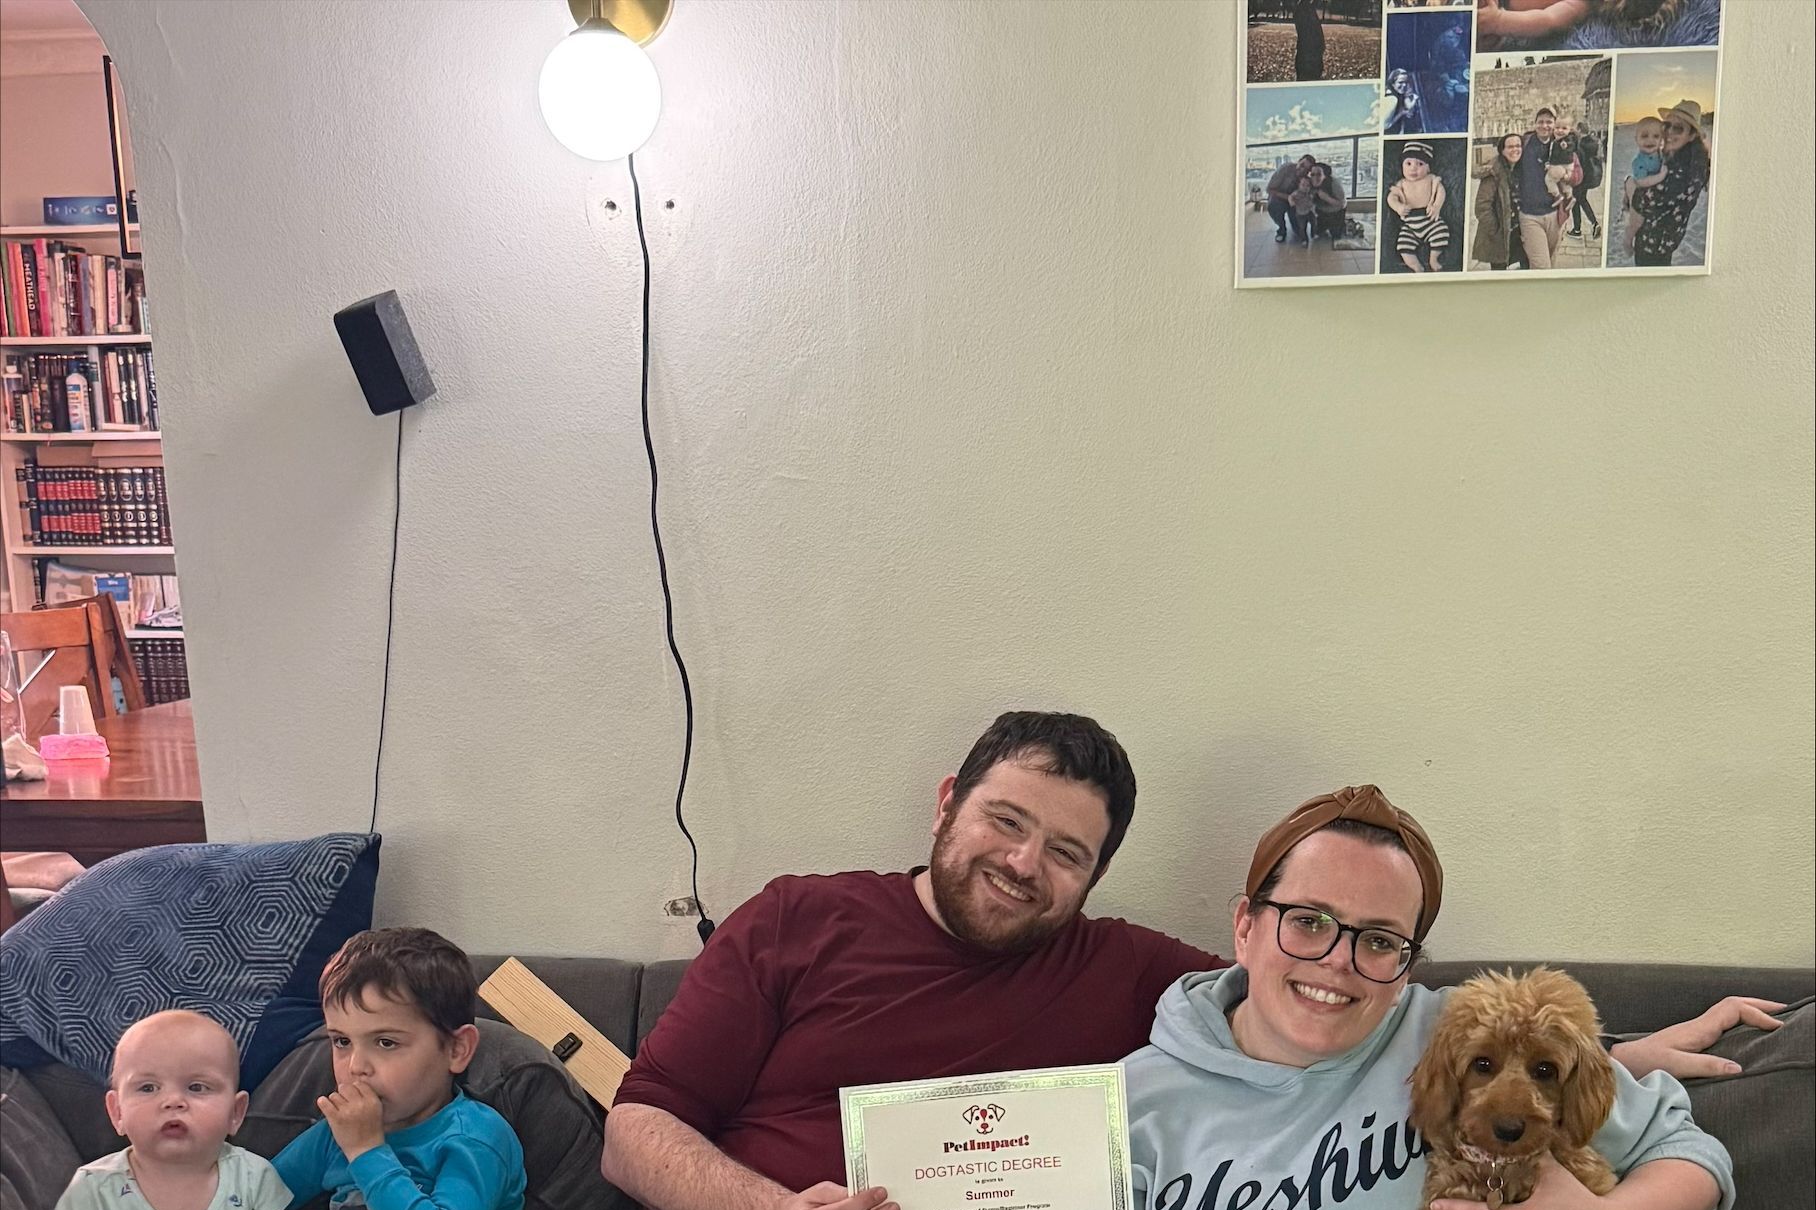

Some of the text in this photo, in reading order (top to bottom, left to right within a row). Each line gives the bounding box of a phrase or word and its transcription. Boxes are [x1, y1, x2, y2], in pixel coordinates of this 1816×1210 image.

[943, 1134, 1030, 1154] PetImpact!
[914, 1156, 1062, 1180] DOGTASTIC DEGREE
[965, 1188, 1015, 1202] Summer
